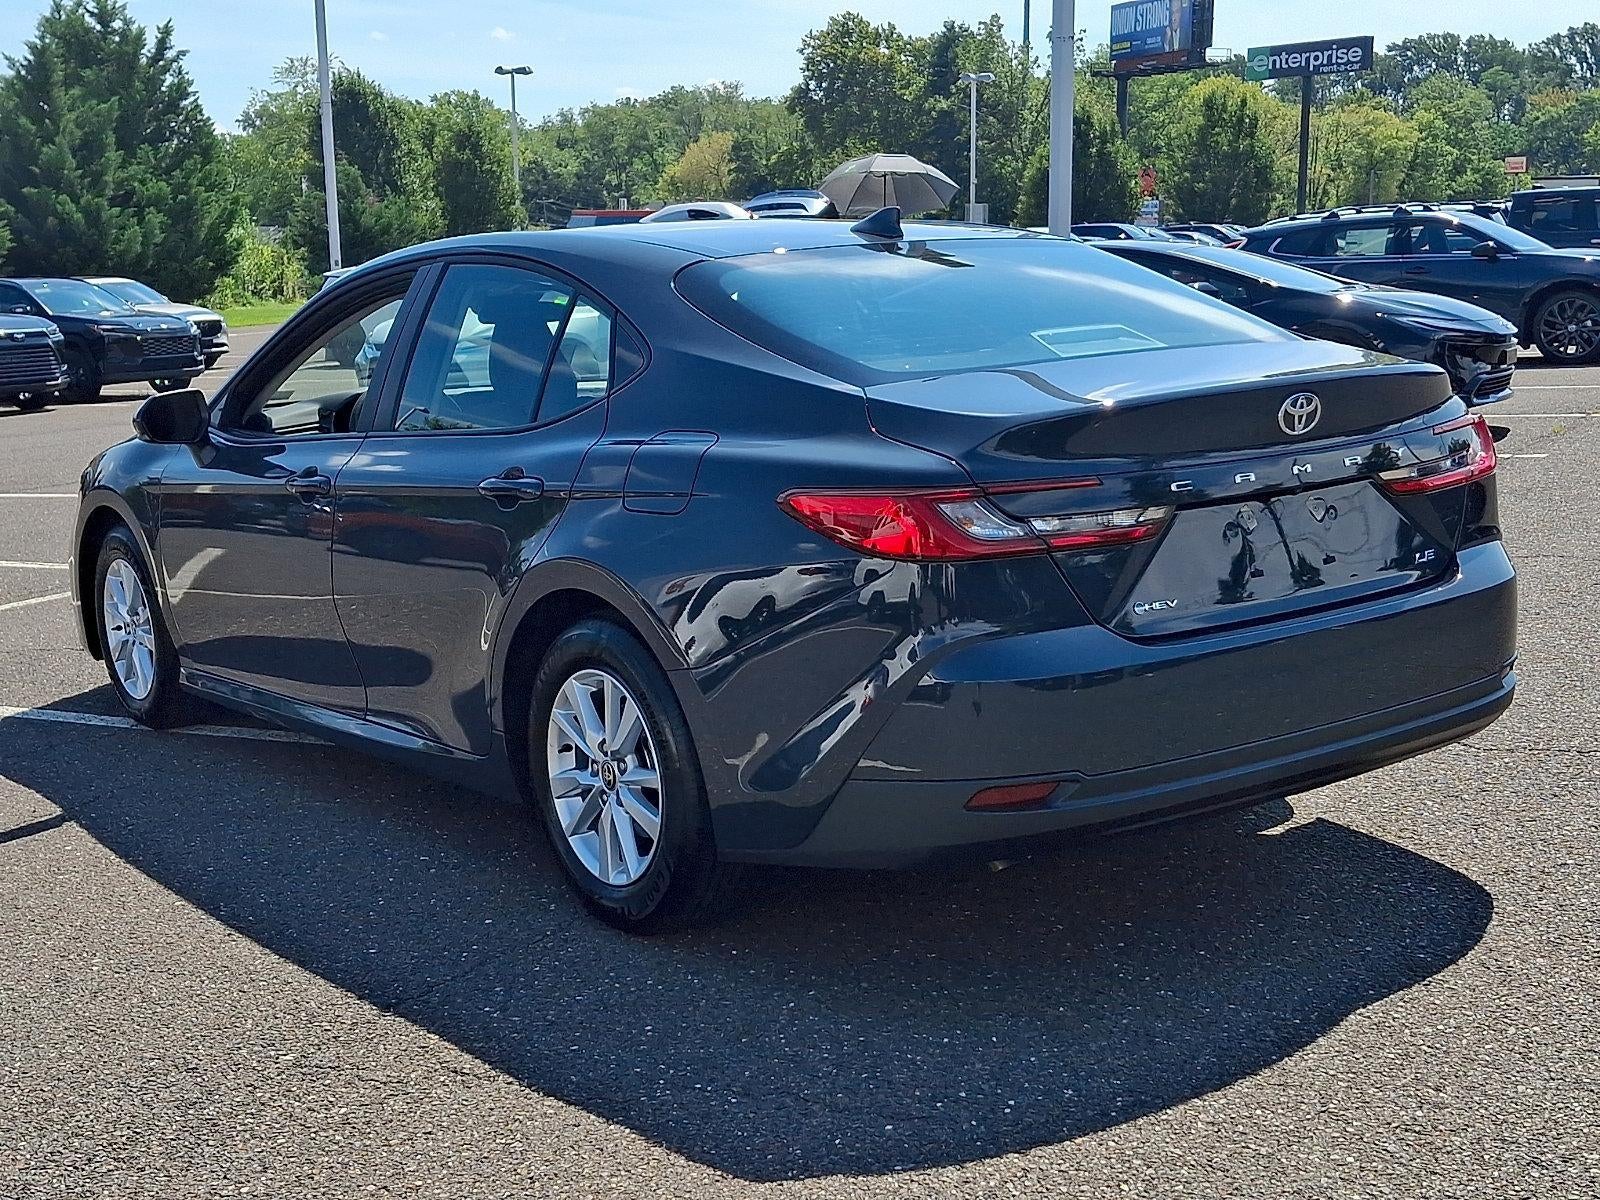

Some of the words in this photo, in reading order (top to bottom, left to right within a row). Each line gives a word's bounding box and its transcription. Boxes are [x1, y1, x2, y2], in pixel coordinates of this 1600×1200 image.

[1112, 6, 1135, 36] UNION
[1136, 0, 1169, 31] STRONG
[1249, 44, 1362, 71] enterprise
[1319, 62, 1361, 72] rent-a-car
[1414, 549, 1435, 564] LE
